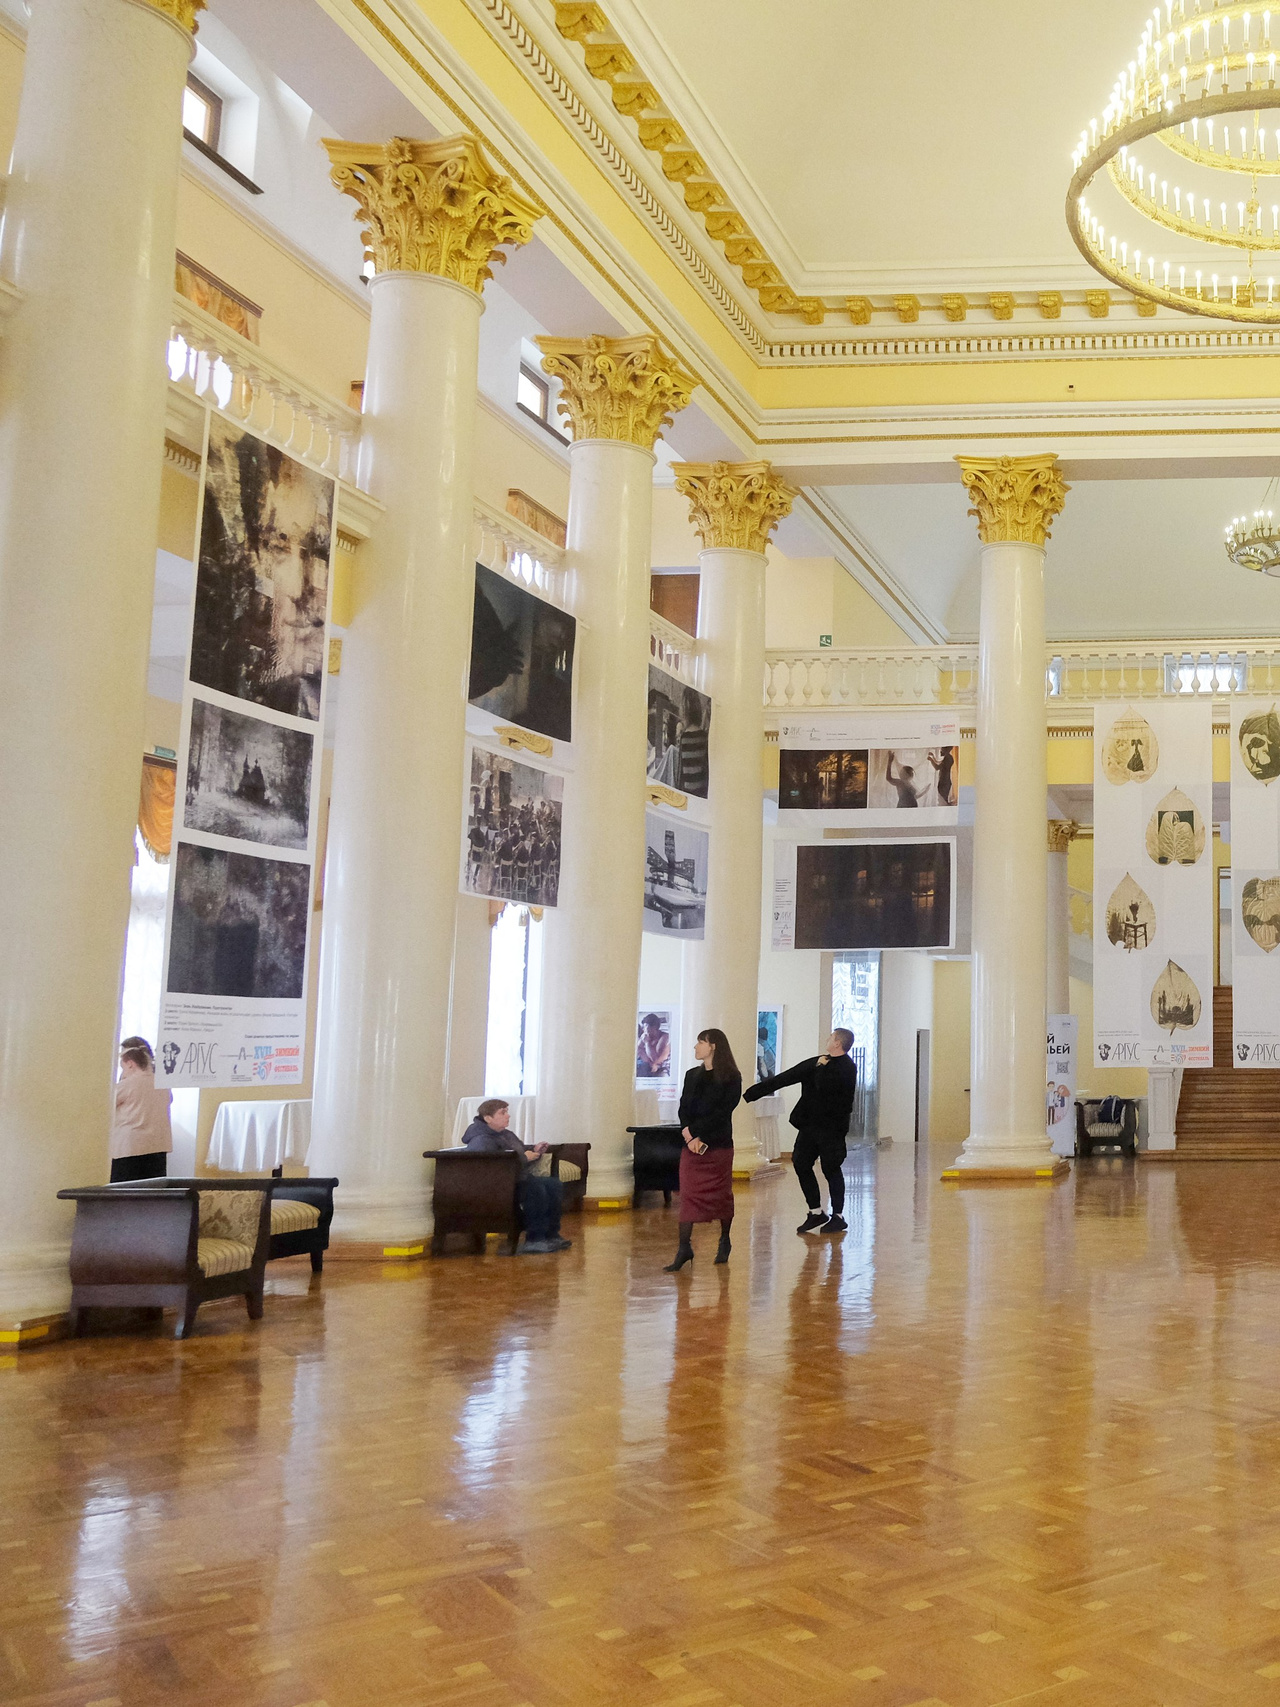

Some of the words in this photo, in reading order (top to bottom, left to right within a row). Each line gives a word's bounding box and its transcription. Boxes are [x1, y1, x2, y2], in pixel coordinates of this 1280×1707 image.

[1047, 1043, 1070, 1054] ЬЕЙ
[1112, 1043, 1140, 1060] АРГУС
[1251, 1044, 1280, 1060] АРГУС
[180, 1042, 218, 1074] АРГУС
